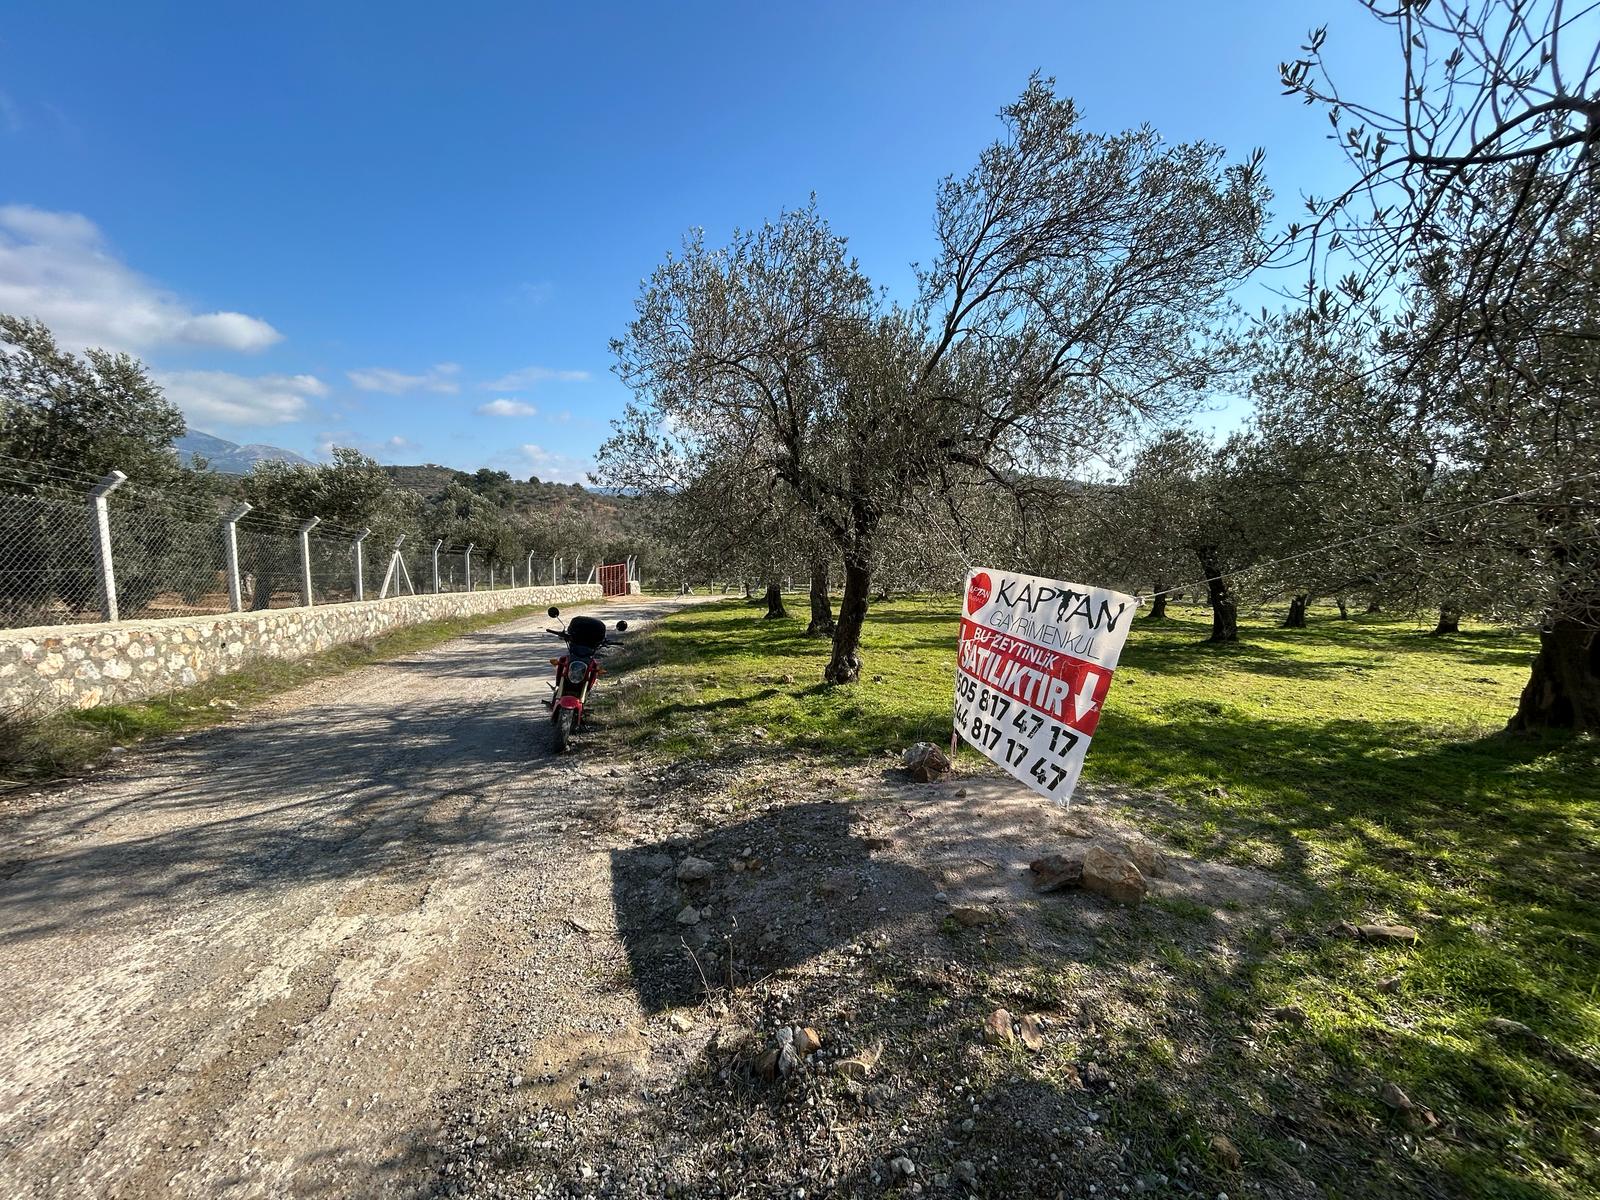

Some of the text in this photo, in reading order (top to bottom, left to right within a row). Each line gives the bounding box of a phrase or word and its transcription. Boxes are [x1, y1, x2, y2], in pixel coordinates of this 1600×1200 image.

[989, 610, 1100, 660] GAYRİMENKUL
[995, 579, 1125, 633] KAPTAN
[973, 627, 1059, 670] BU ZEYTİNLİK
[961, 642, 1070, 717] SATILIKTIR
[979, 688, 1011, 721] 817
[1012, 709, 1044, 739] 47
[1049, 725, 1079, 757] 17
[971, 716, 1002, 750] 817
[1005, 738, 1029, 768] 17
[1030, 757, 1067, 792] 47
